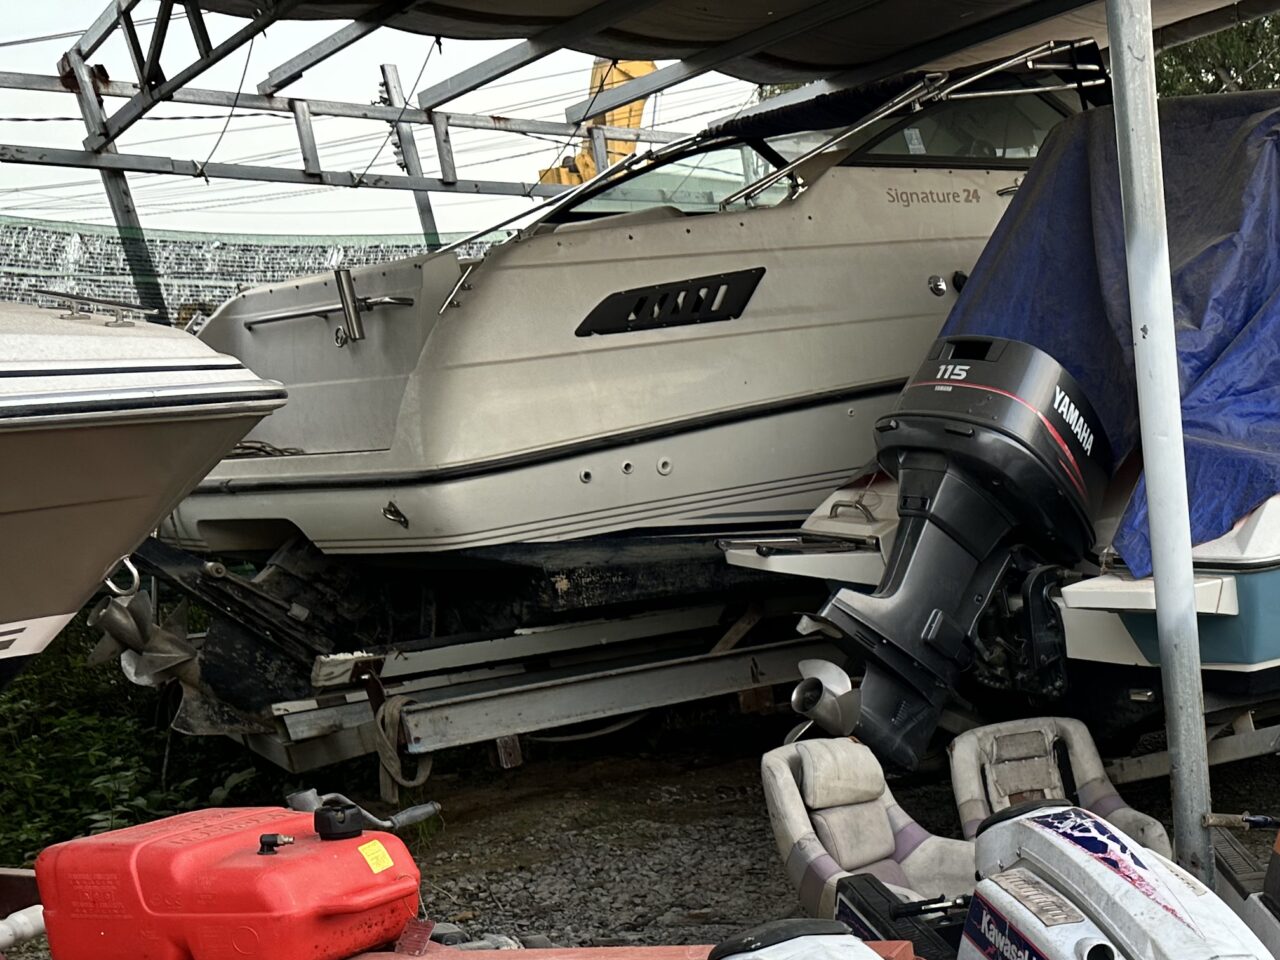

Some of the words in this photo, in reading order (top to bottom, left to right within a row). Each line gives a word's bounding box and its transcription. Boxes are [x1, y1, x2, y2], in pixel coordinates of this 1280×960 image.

[886, 187, 960, 207] Signature
[962, 188, 980, 203] 24
[936, 365, 971, 380] 115
[1053, 385, 1094, 457] YAMAHA
